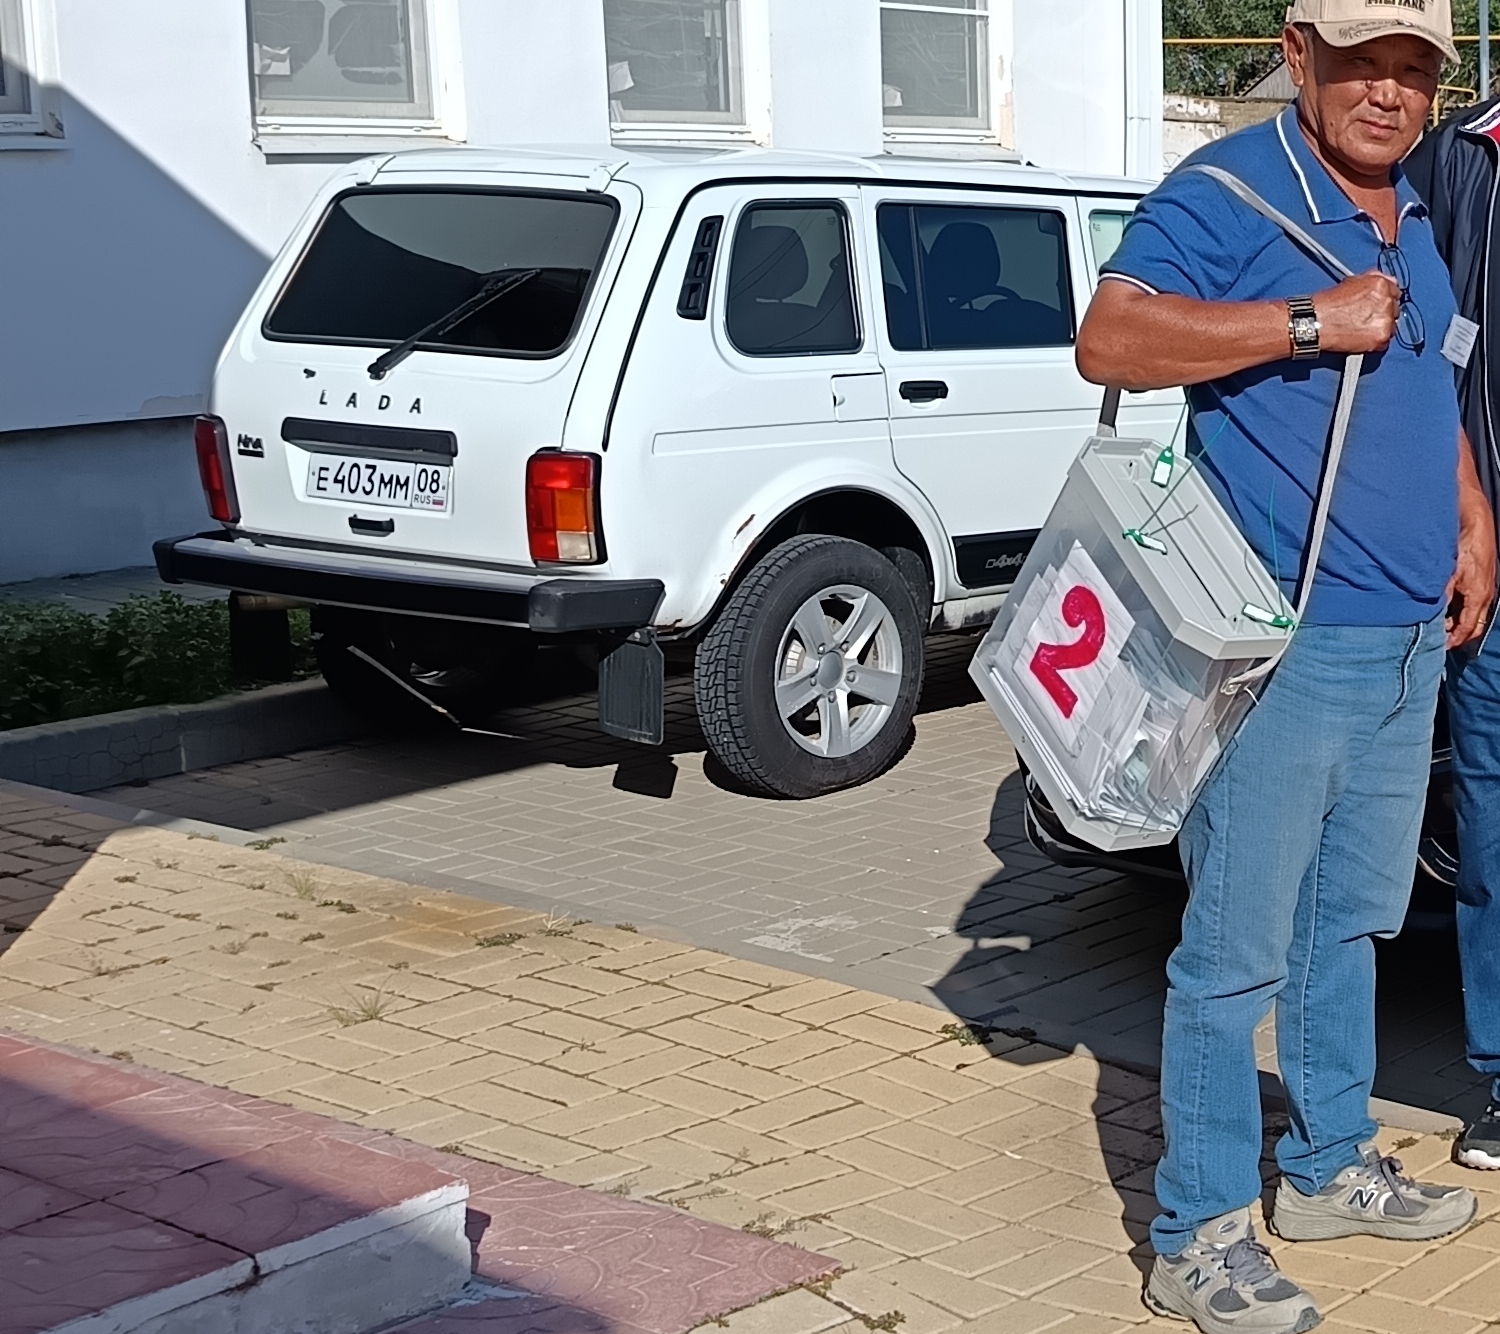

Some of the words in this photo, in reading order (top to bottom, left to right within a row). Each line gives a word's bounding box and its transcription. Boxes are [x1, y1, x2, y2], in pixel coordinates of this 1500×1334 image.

[319, 389, 422, 415] LADA
[417, 467, 441, 495] 08
[413, 493, 432, 505] RUS
[1029, 585, 1106, 720] 2
[1347, 1186, 1378, 1212] N
[1184, 1265, 1213, 1293] N
